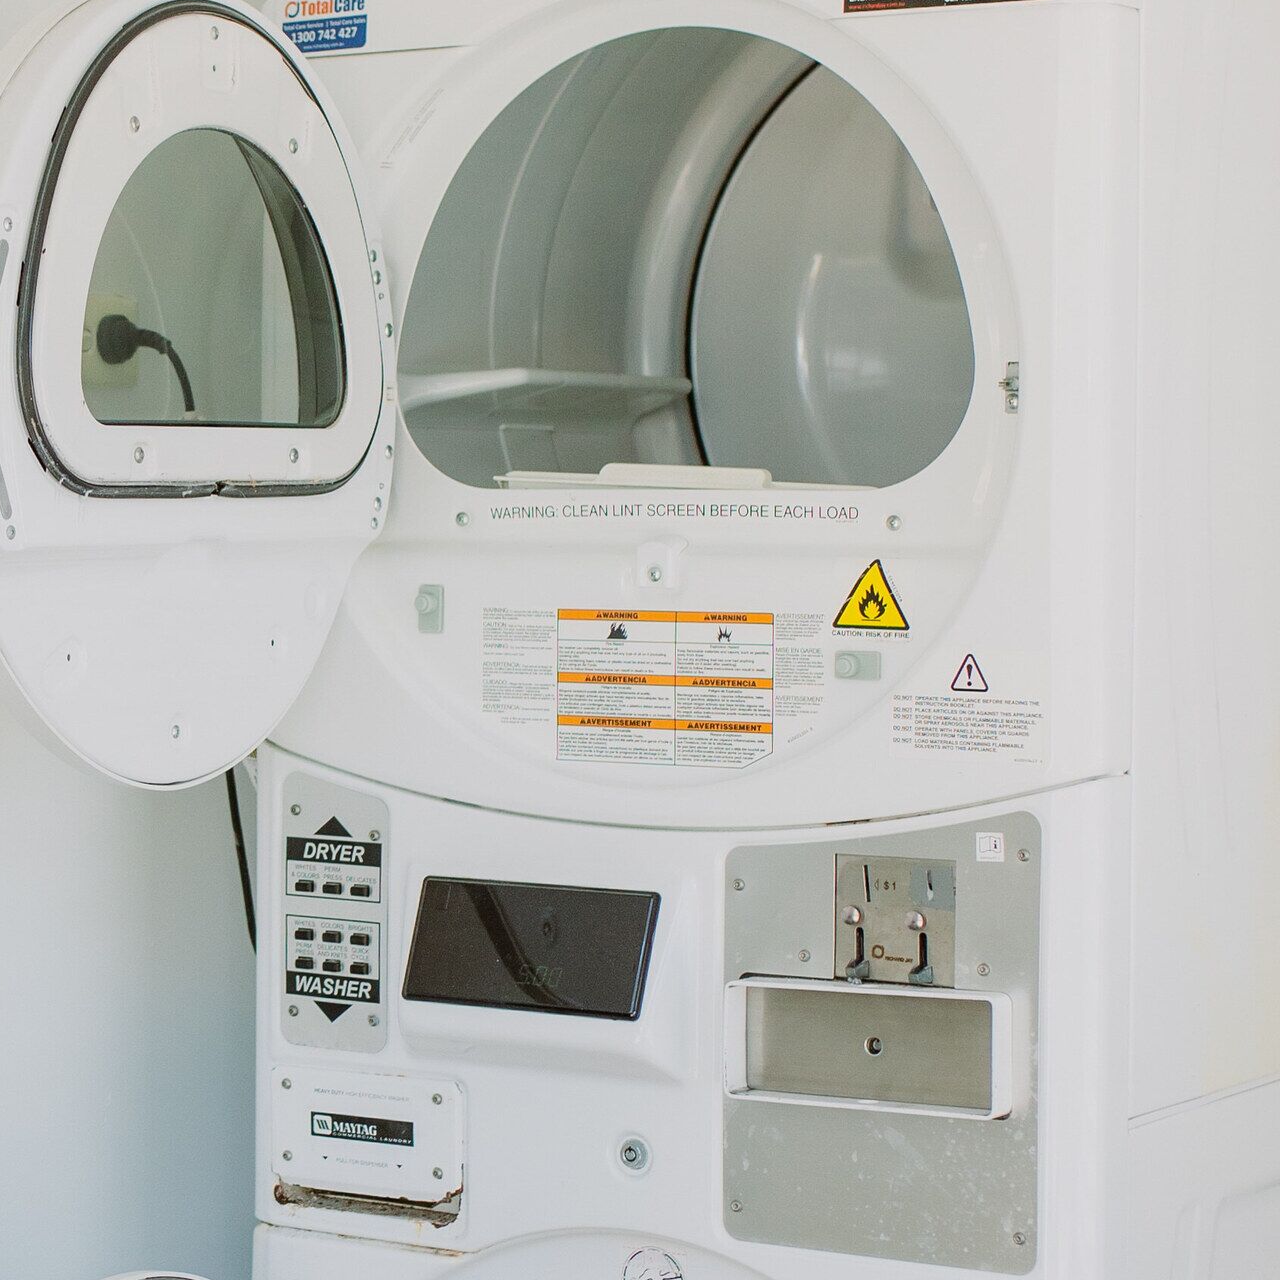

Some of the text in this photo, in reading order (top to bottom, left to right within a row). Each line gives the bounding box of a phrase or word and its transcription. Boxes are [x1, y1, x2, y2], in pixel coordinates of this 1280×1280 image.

[290, 26, 358, 43] 1300 742 427
[490, 504, 859, 520] WARNING: CLEAN LINT SCREEN BEFORE EACH LOAD
[602, 611, 638, 620] WARNING
[710, 614, 748, 622] WARNING
[590, 674, 647, 684] ADVERTENCIA
[699, 678, 757, 687] ADVERTENCIA
[587, 718, 652, 727] AVERTISSEMENT
[693, 723, 762, 731] AVERTISSEMENT
[303, 842, 366, 863] DRYER
[295, 974, 372, 999] WASHER
[332, 1121, 378, 1136] MAYTAG
[332, 1131, 412, 1144] COMMERCIAL LAUNDRY
